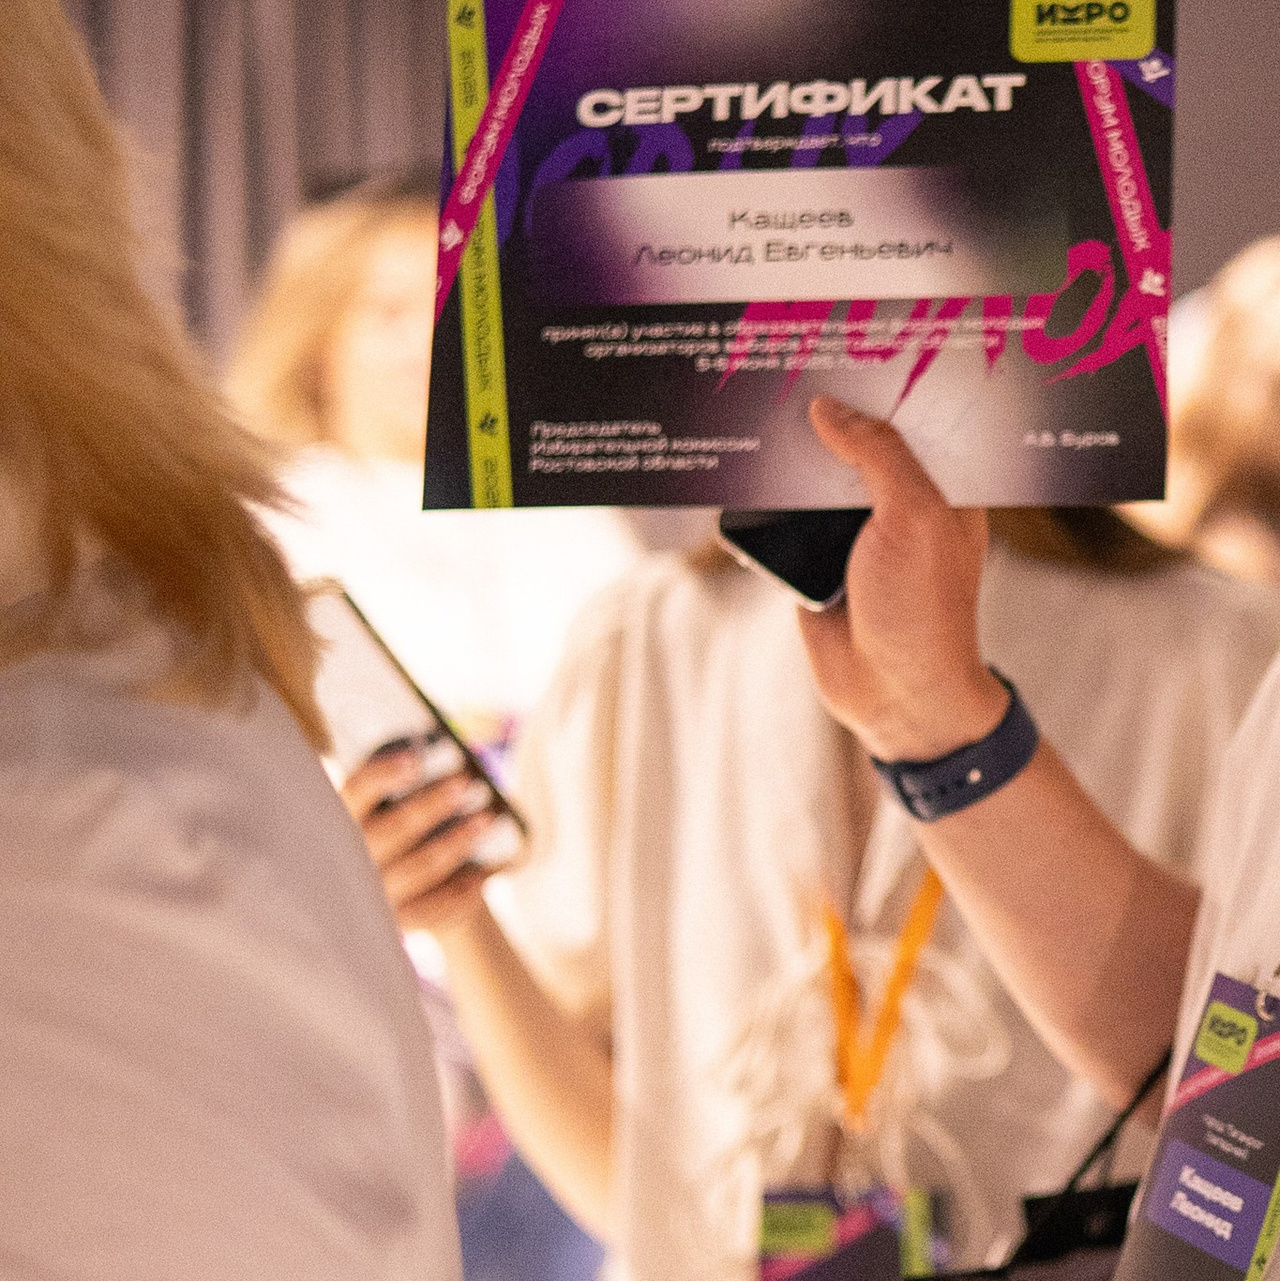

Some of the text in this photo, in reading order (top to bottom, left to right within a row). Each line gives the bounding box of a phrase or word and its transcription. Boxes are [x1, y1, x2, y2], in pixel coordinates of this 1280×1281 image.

[458, 2, 551, 205] ФОРУМ МОЛОДЫХ
[576, 73, 1027, 128] СЕРТИФИКАТ
[1086, 60, 1151, 253] ОРУМ МОЛОДЫХ
[635, 238, 953, 266] Леонид Евгеньевич
[632, 322, 705, 340] участие
[529, 420, 663, 438] Председатель
[529, 436, 761, 455] Избирательной комиссии
[528, 454, 720, 472] Ростовской области
